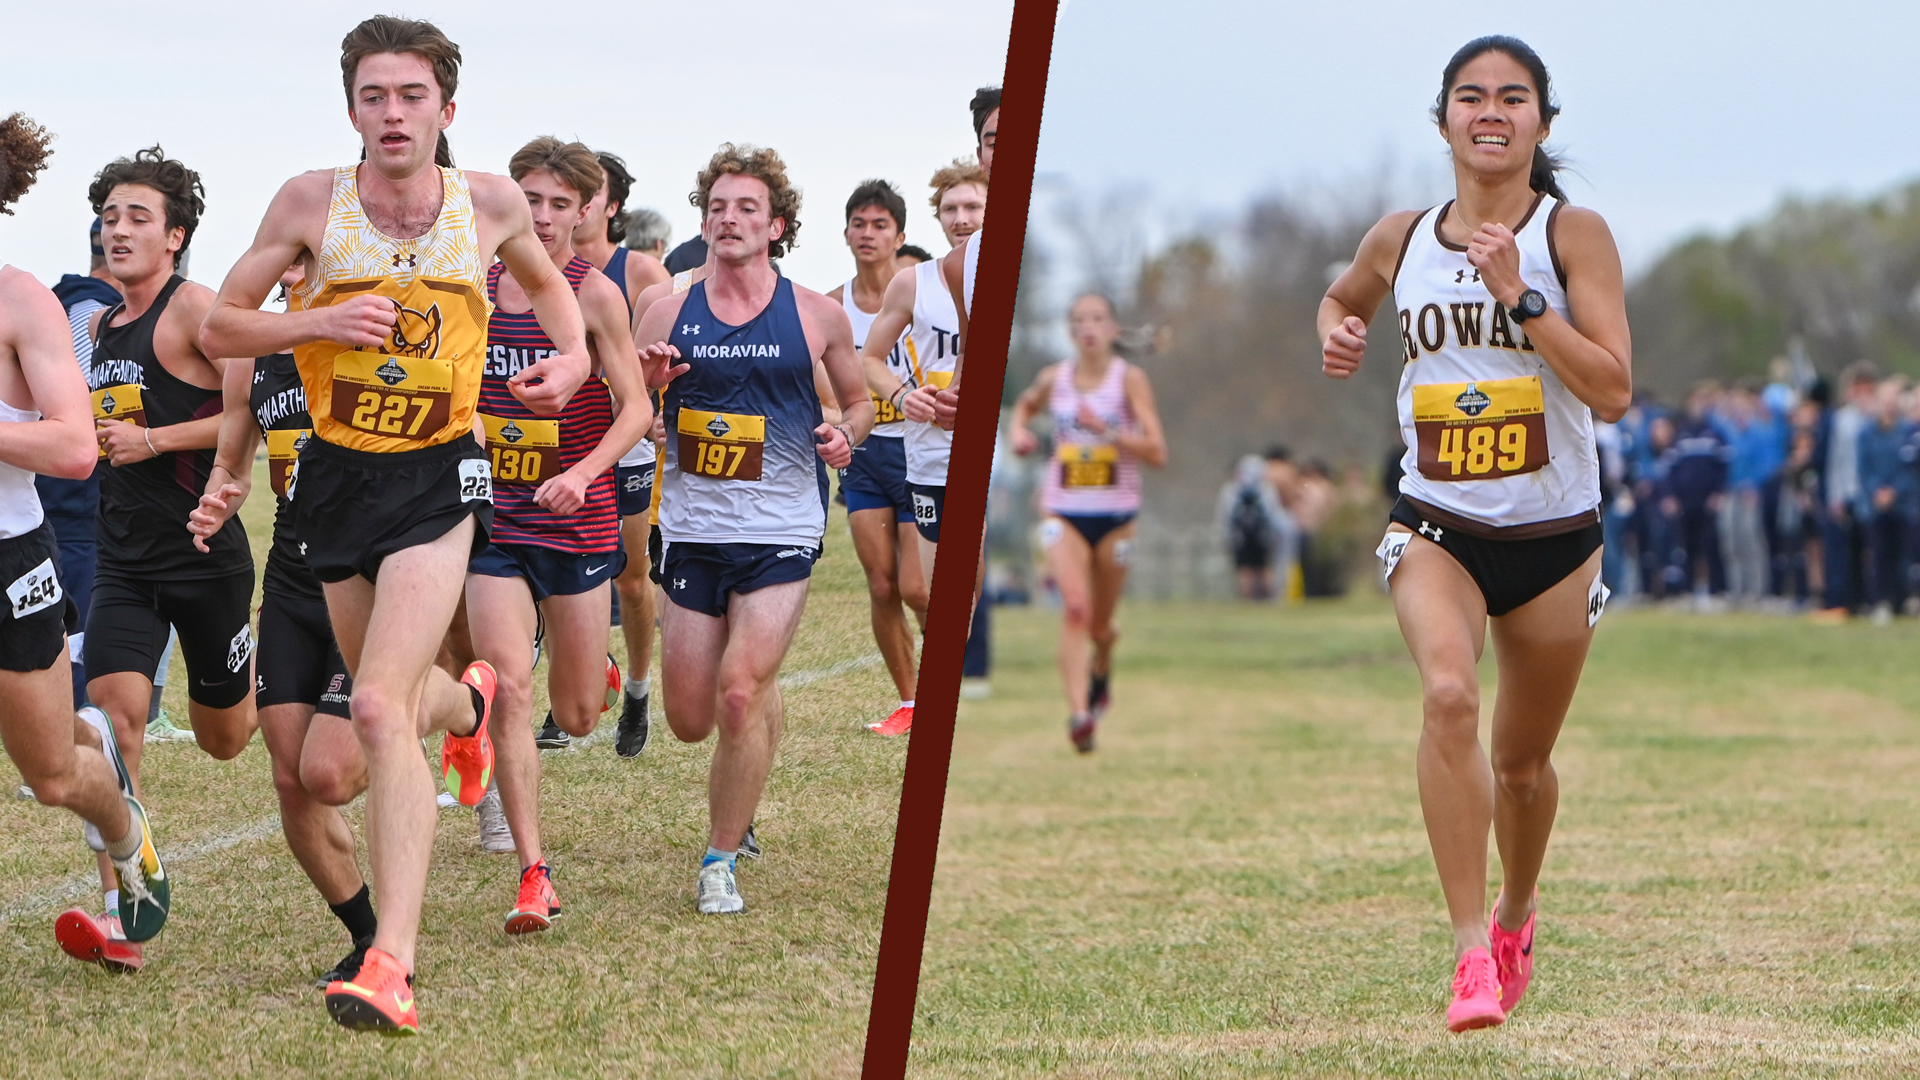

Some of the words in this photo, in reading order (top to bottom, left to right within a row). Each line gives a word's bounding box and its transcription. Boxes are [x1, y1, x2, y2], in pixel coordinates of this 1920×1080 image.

[692, 344, 780, 358] MORAVIAN
[1399, 300, 1537, 366] ROWA
[257, 386, 308, 433] SWARTH
[352, 390, 434, 436] 227
[491, 447, 542, 481] 130
[695, 441, 747, 477] 197
[1437, 423, 1528, 476] 489
[327, 673, 346, 693] S
